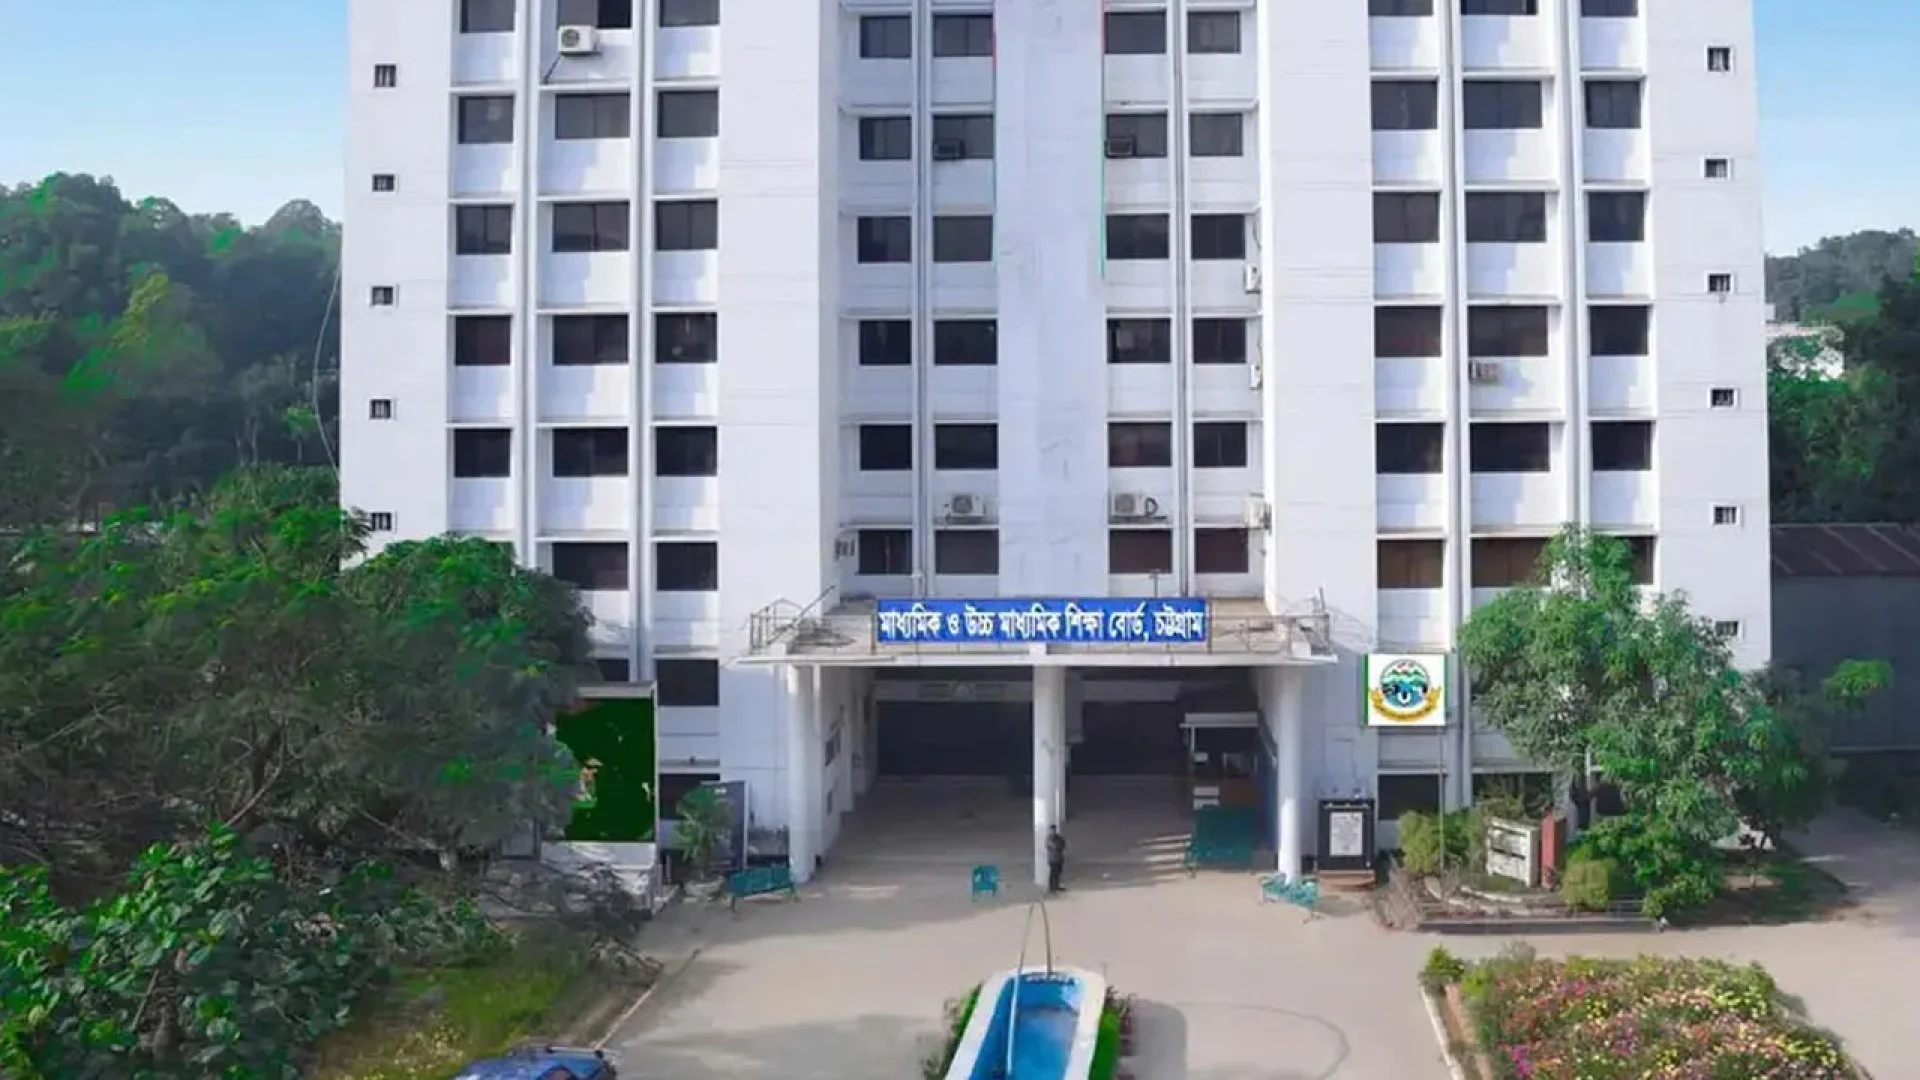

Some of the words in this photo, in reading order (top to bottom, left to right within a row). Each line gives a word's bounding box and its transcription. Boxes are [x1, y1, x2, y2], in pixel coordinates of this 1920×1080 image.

[879, 602, 942, 639] মাধ্যমিক
[946, 612, 960, 635] ও
[963, 603, 995, 636] উচ্চ
[999, 602, 1061, 639] মাধ্যমিক
[1065, 602, 1104, 639] শিক্ষা
[1109, 601, 1149, 642] বোর্ড,
[1152, 602, 1204, 639] চট্টগ্রাম
